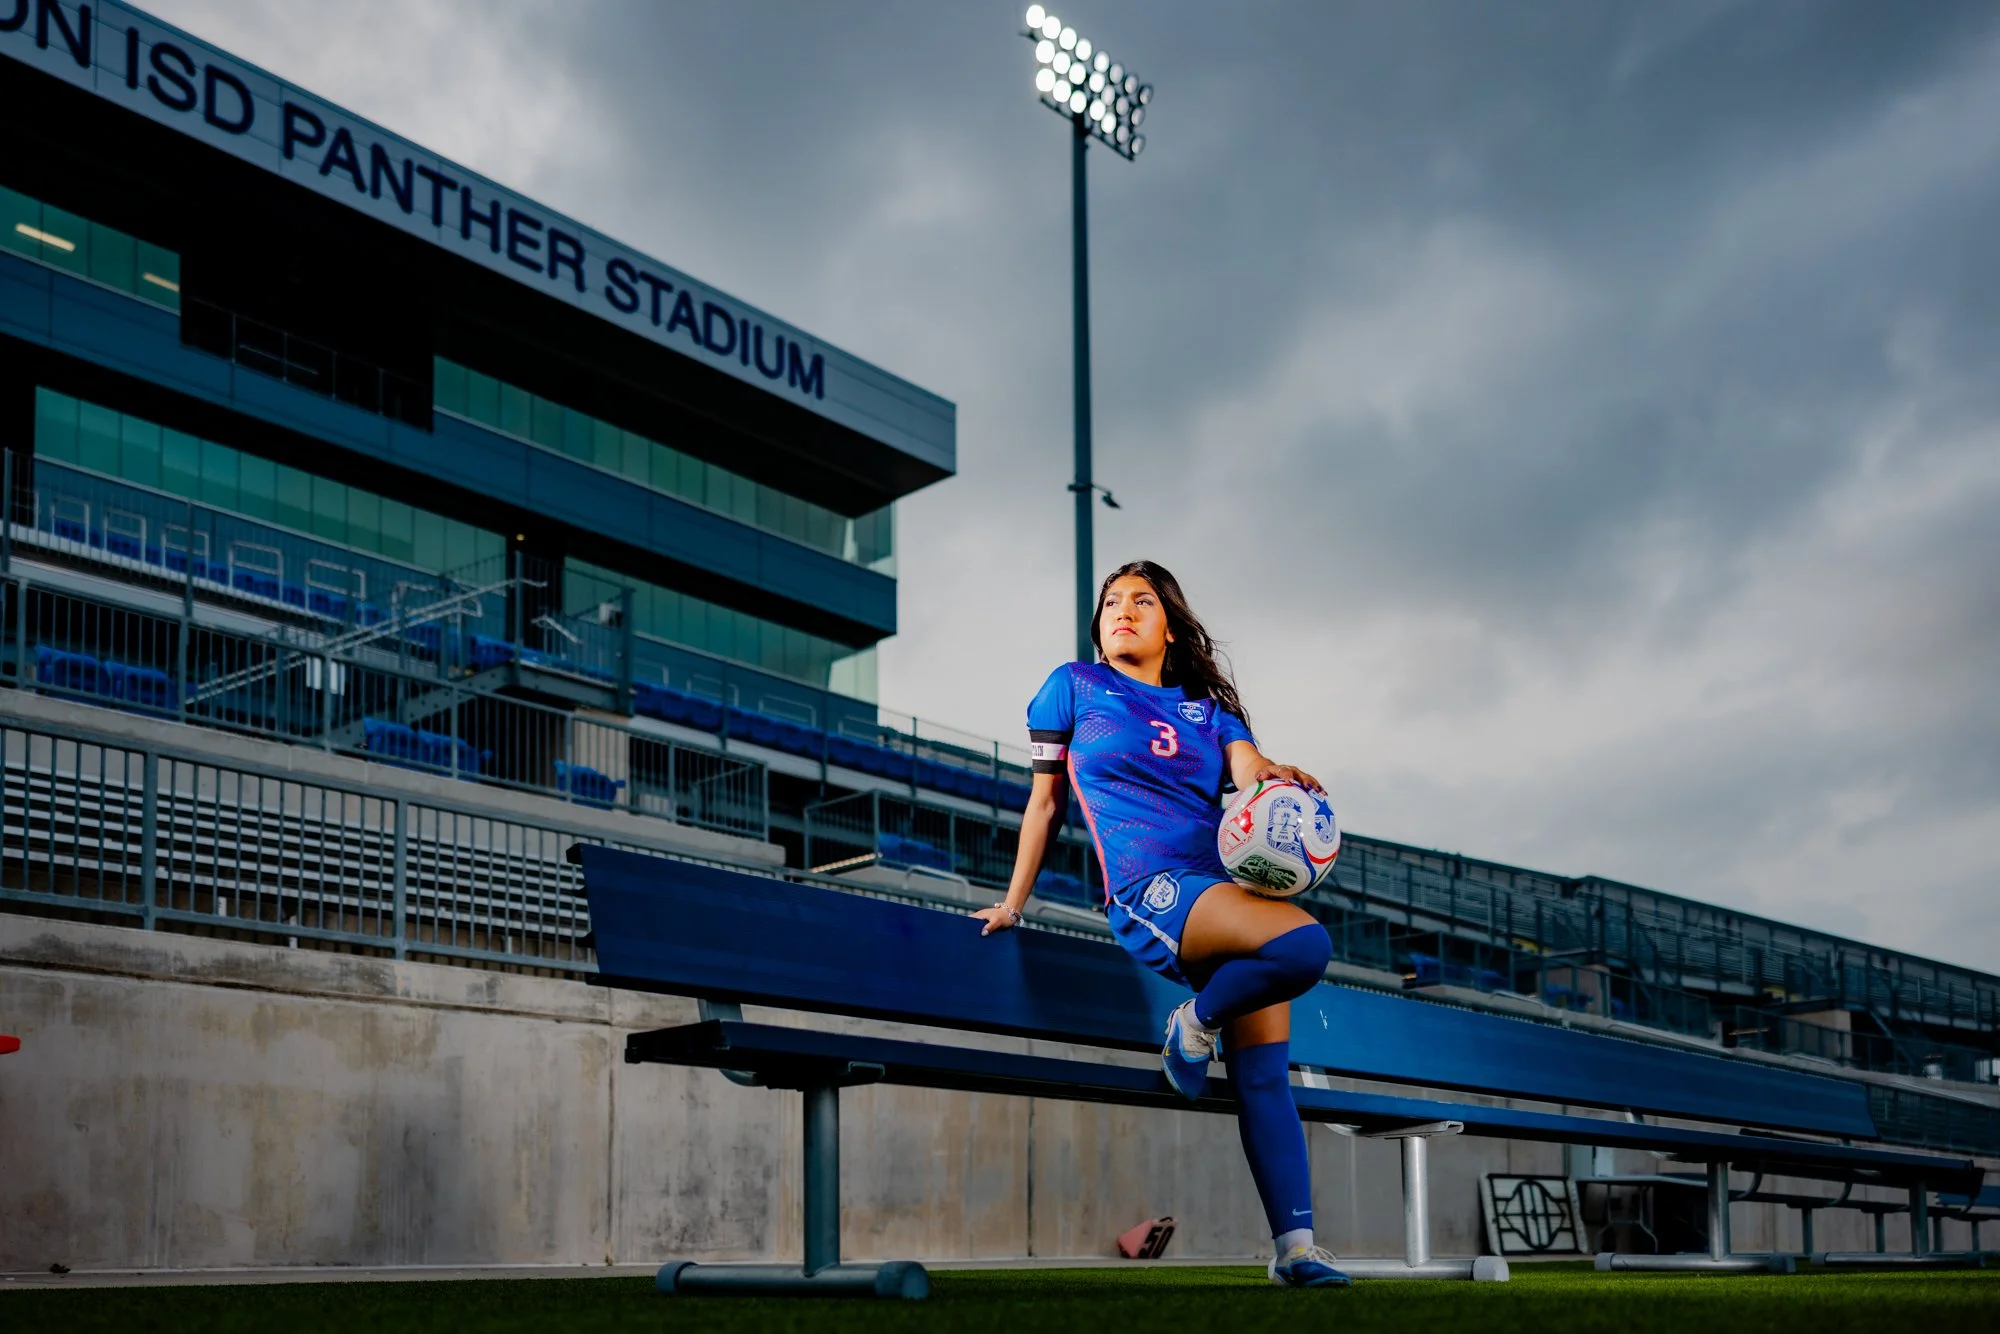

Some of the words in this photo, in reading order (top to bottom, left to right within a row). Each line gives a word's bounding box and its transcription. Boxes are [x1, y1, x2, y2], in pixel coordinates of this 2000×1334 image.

[126, 26, 255, 135] ISD
[282, 100, 586, 293] PANTHER
[604, 257, 825, 400] STADIUM
[1150, 720, 1178, 758] 3
[1137, 1225, 1175, 1259] 50
